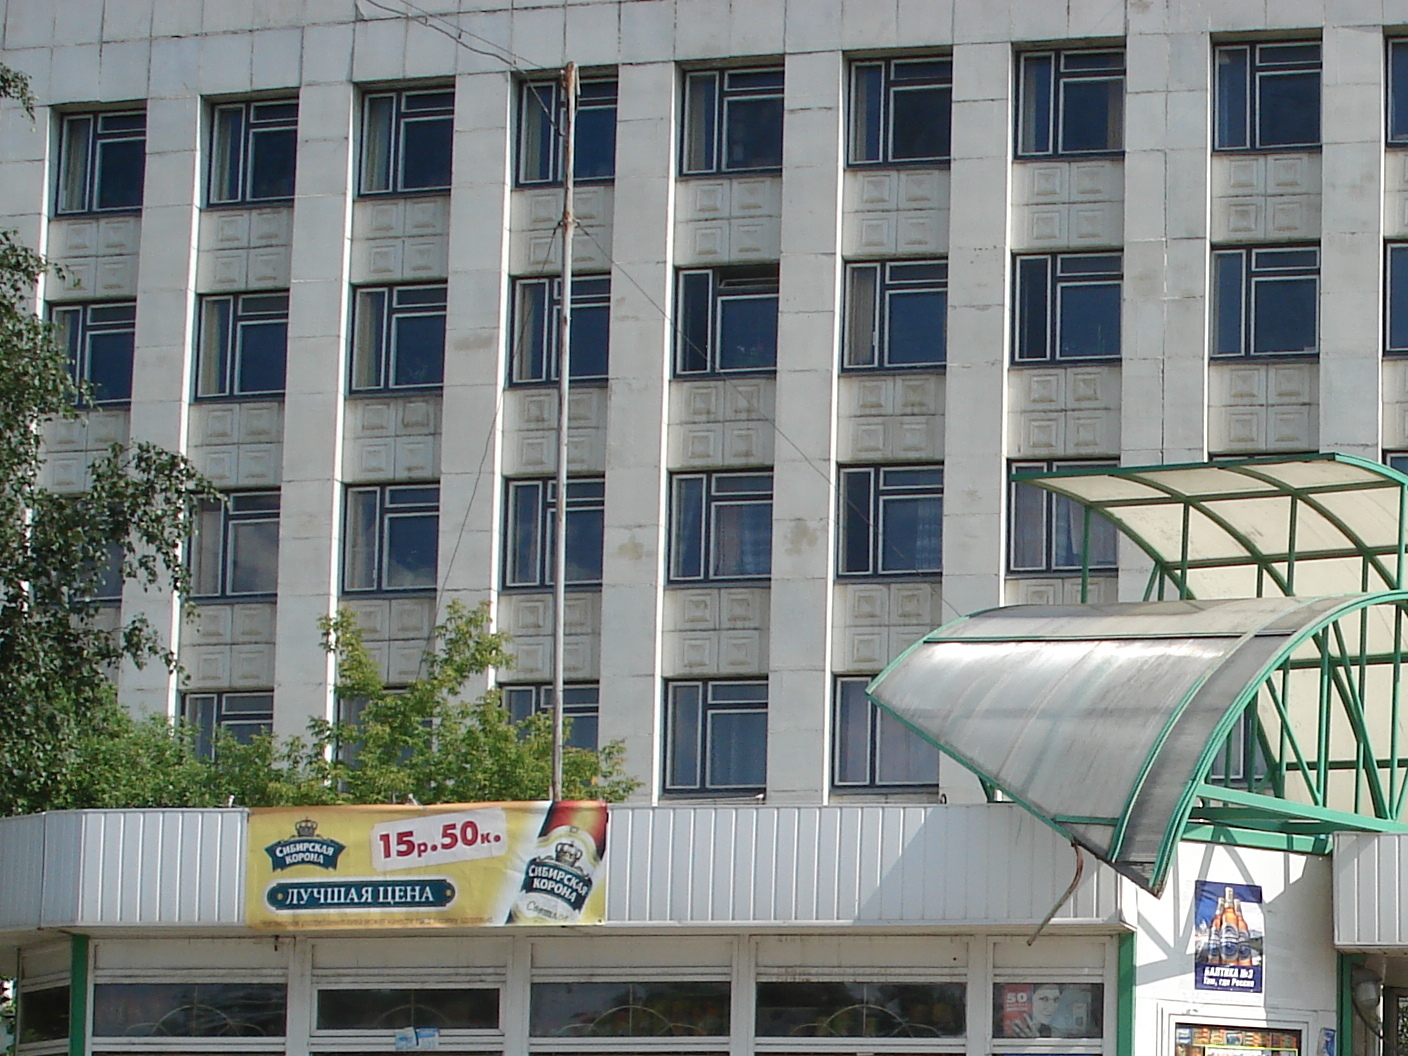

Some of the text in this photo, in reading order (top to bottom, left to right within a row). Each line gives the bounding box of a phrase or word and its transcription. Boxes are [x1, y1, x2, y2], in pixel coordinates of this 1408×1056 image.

[275, 842, 334, 857] СИБИРСКАЯ
[284, 852, 324, 865] КОРОНА
[528, 864, 588, 896] СИБИРСКАЯ
[285, 885, 435, 905] ЛУЧШАЯ ЦЕНА
[533, 878, 577, 902] КОРОНА
[1006, 992, 1028, 1003] 50
